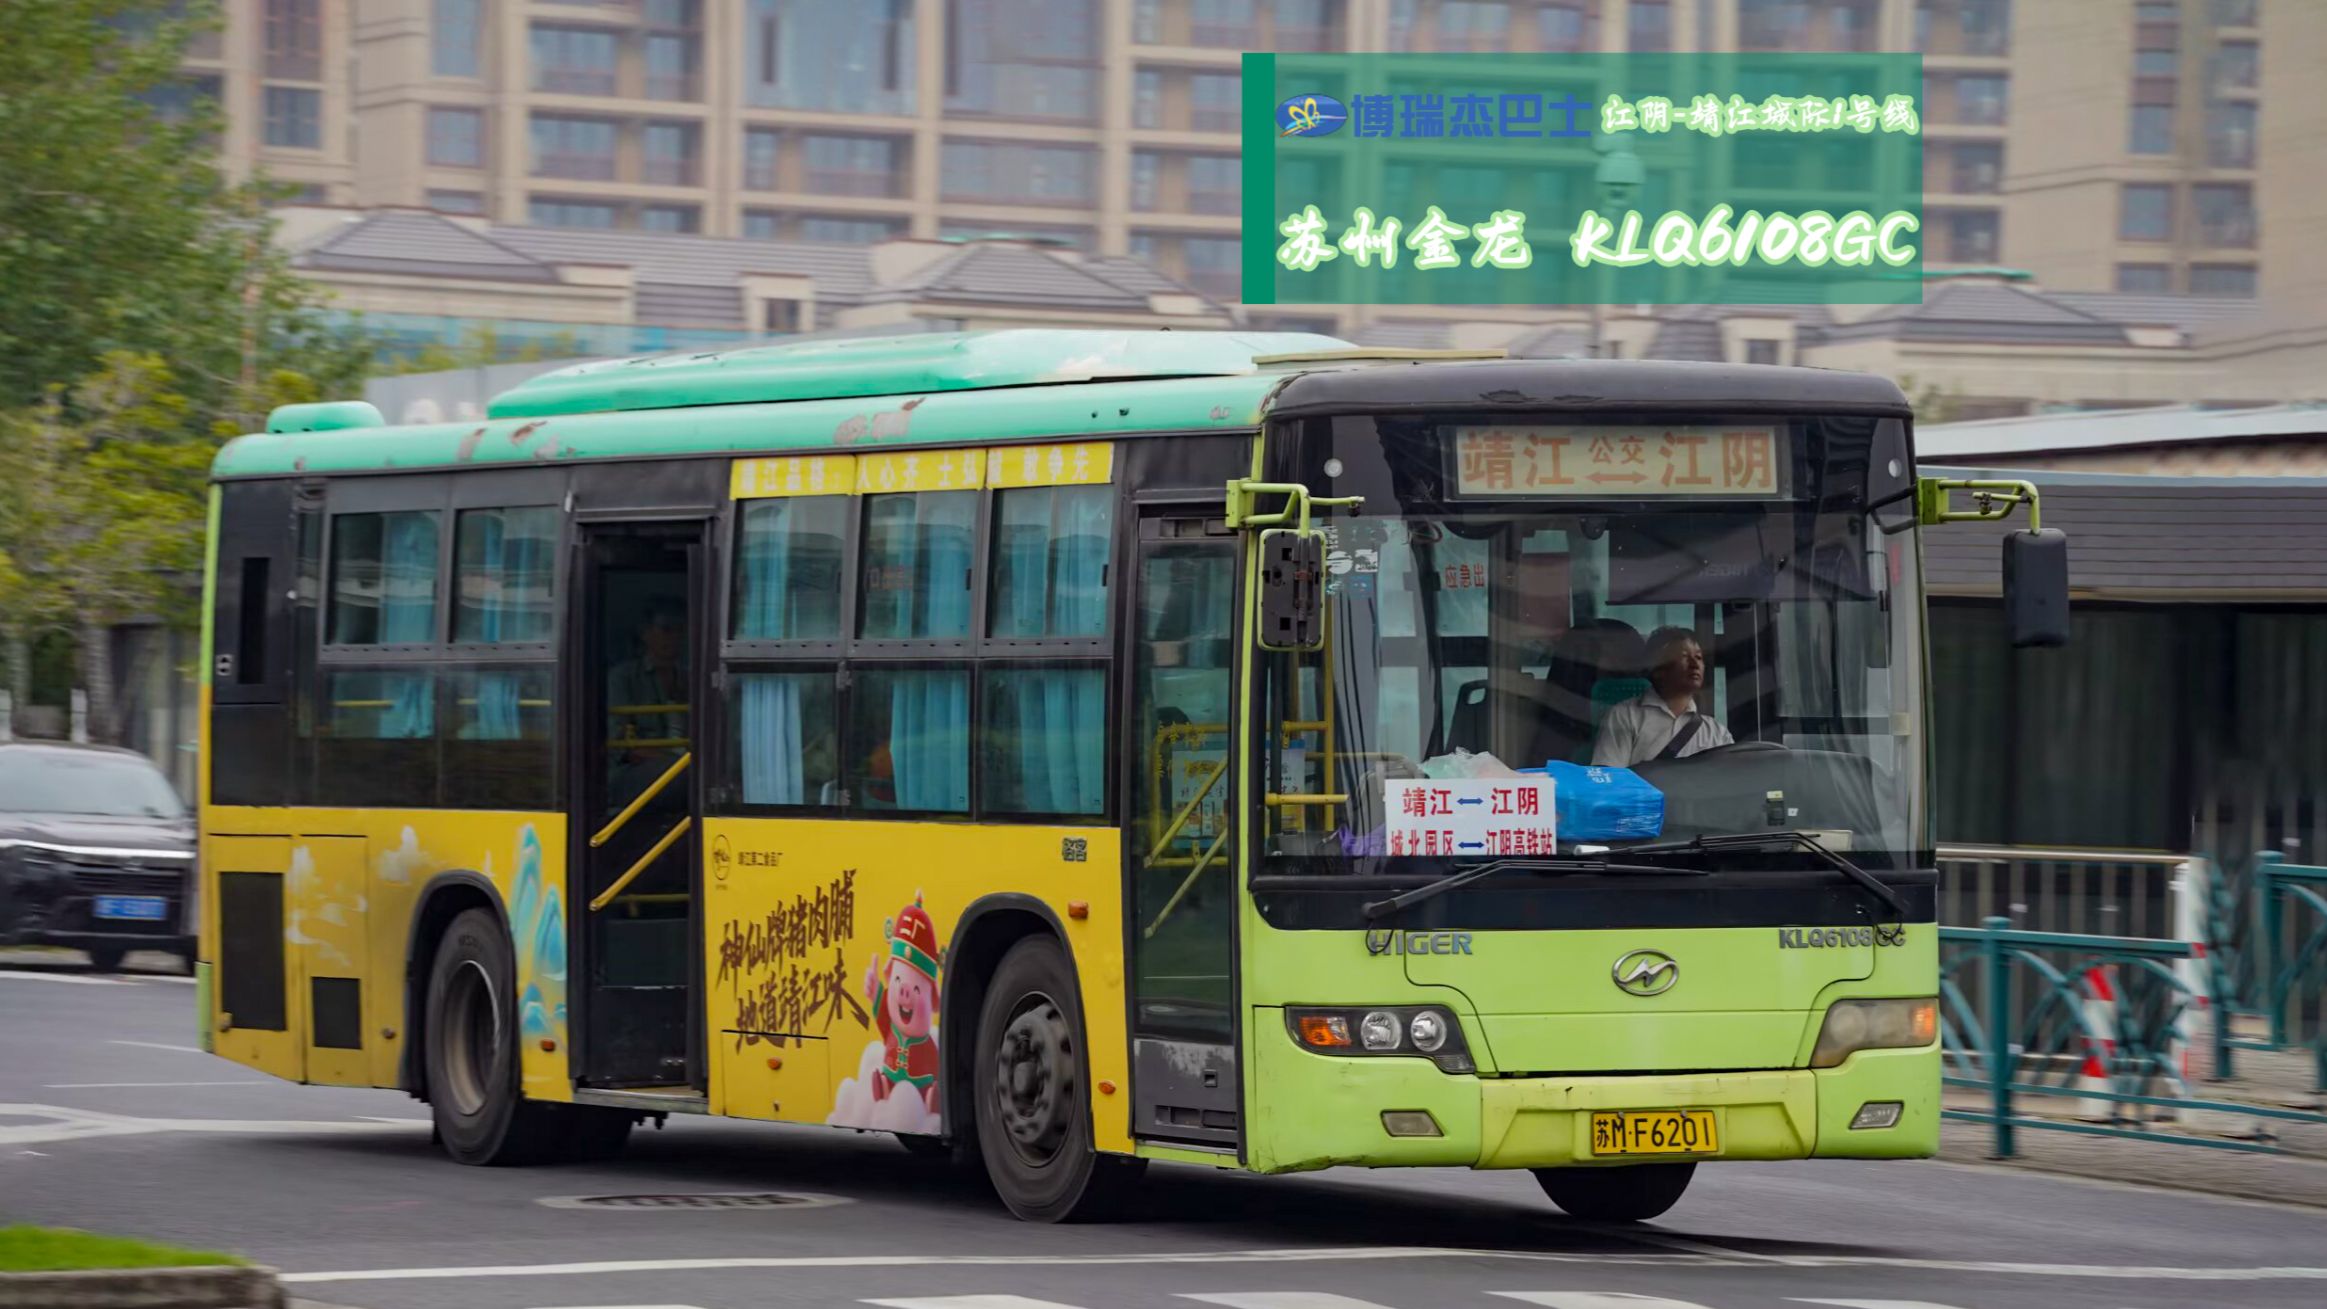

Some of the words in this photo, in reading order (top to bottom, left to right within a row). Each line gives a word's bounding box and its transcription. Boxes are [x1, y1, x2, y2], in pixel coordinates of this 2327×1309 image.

[1462, 430, 1574, 489] 靖江
[1588, 435, 1645, 465] 公交
[1658, 431, 1771, 488] 江阴
[1403, 788, 1453, 816] 靖江
[1491, 787, 1539, 816] 江阴
[1391, 829, 1454, 855] 城北园区
[1486, 828, 1552, 855] 江阴高铁站
[715, 868, 857, 1003] 神仙牌猪肉脯
[1369, 932, 1473, 956] HIGER
